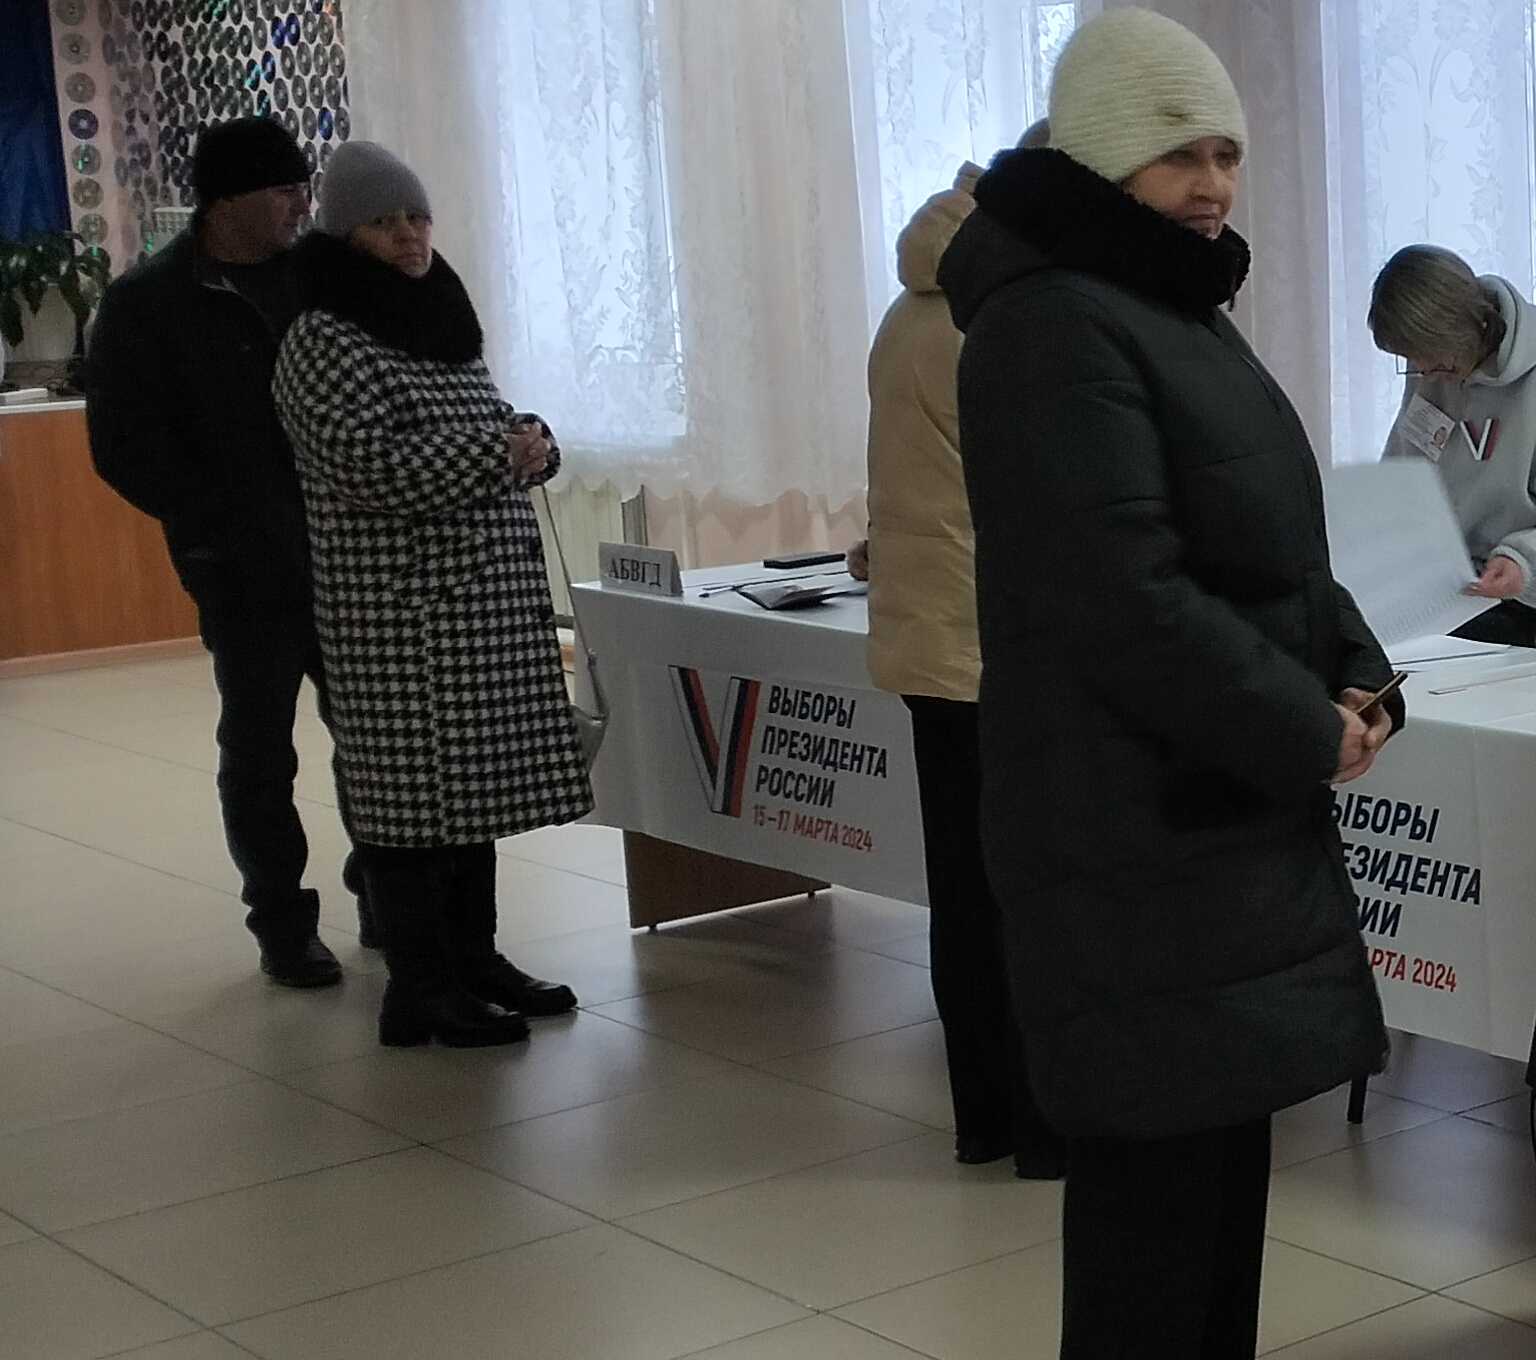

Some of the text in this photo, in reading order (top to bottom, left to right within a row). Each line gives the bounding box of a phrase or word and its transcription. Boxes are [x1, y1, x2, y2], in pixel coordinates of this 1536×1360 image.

[609, 557, 661, 587] АБВГД
[767, 685, 857, 729] ВЫБОРЫ
[760, 725, 888, 779] ПРЕЗИДЕНТА
[756, 765, 835, 808] РОССИИ
[793, 815, 838, 844] МАРТА
[843, 824, 873, 852] 2024
[1331, 791, 1440, 843] ЫБОРЫ
[1343, 843, 1481, 905] ЗИДЕНТА
[1364, 947, 1456, 992] РТА 2024
